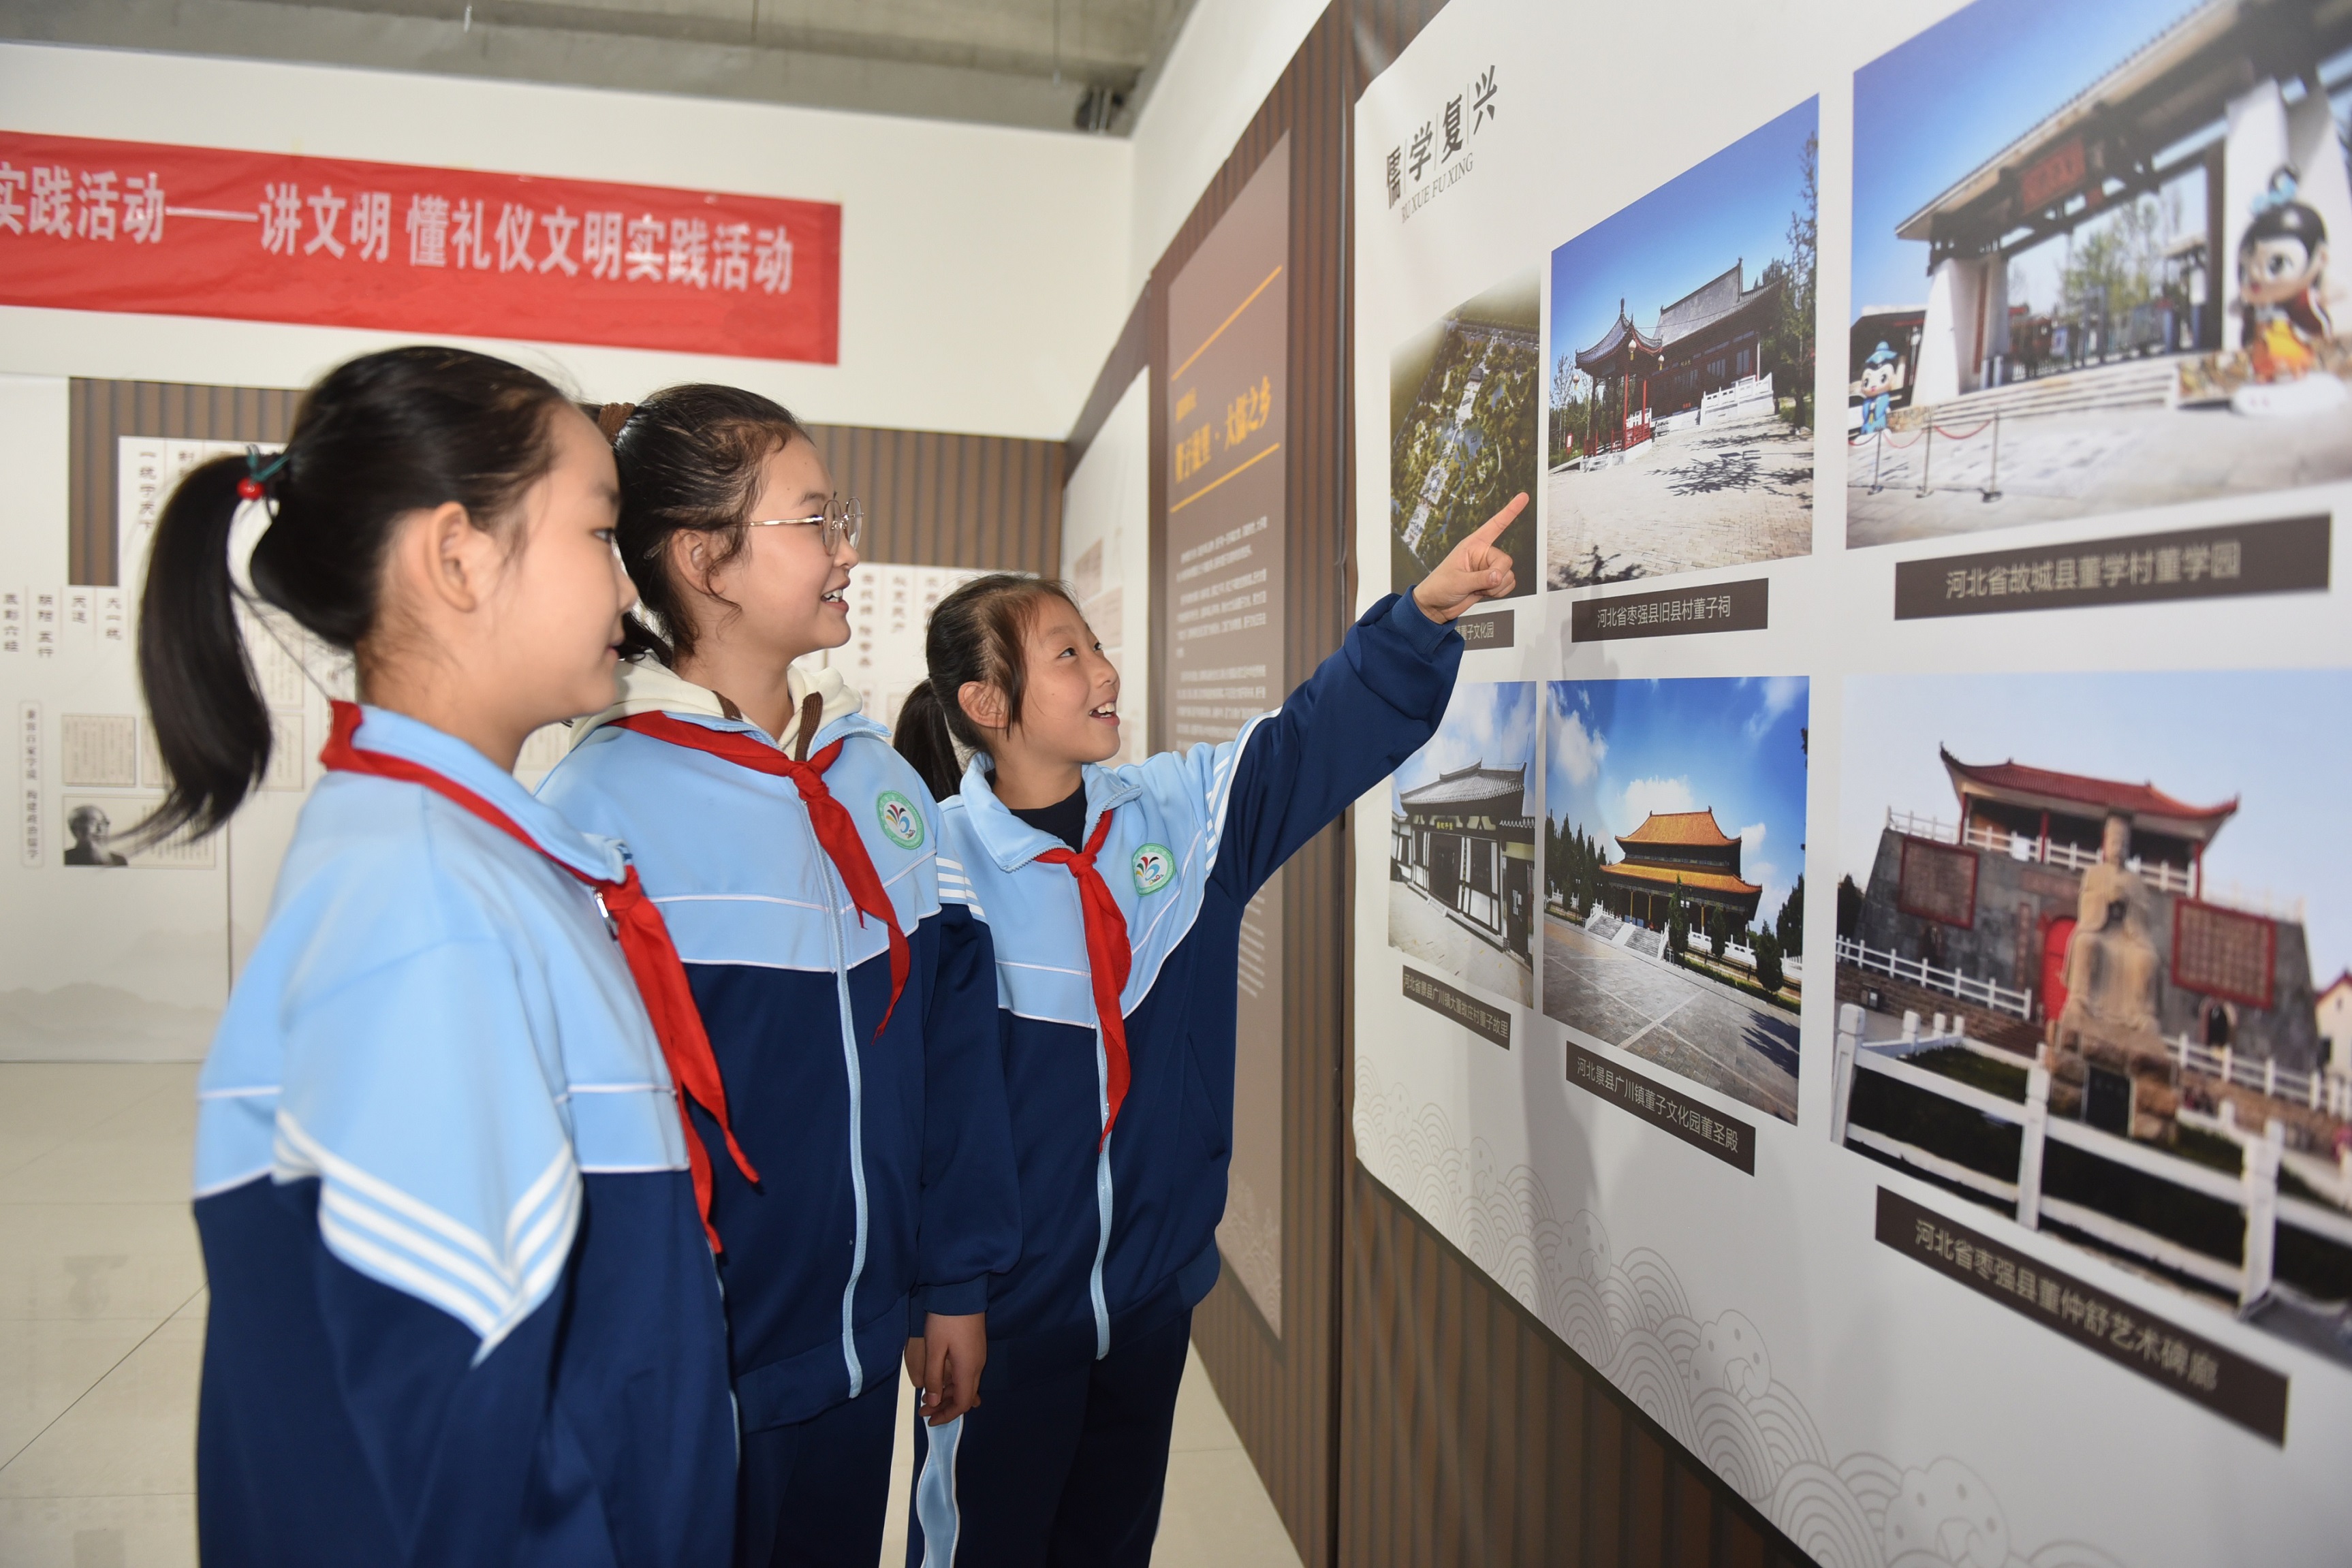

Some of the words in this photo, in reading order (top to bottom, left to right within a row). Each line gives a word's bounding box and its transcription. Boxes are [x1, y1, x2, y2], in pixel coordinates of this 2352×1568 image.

[1387, 65, 1498, 210] 儒学复兴
[1401, 200, 1411, 223] RU
[1411, 185, 1430, 214] XUE
[1432, 173, 1447, 198] FU
[1447, 153, 1473, 188] XING
[406, 193, 794, 295] 懂礼仪文明实践活动
[1597, 595, 1731, 628] 河北省枣强县旧县村董子祠
[1577, 1056, 1738, 1153] 河北景县广川镇董子文化园董圣殿
